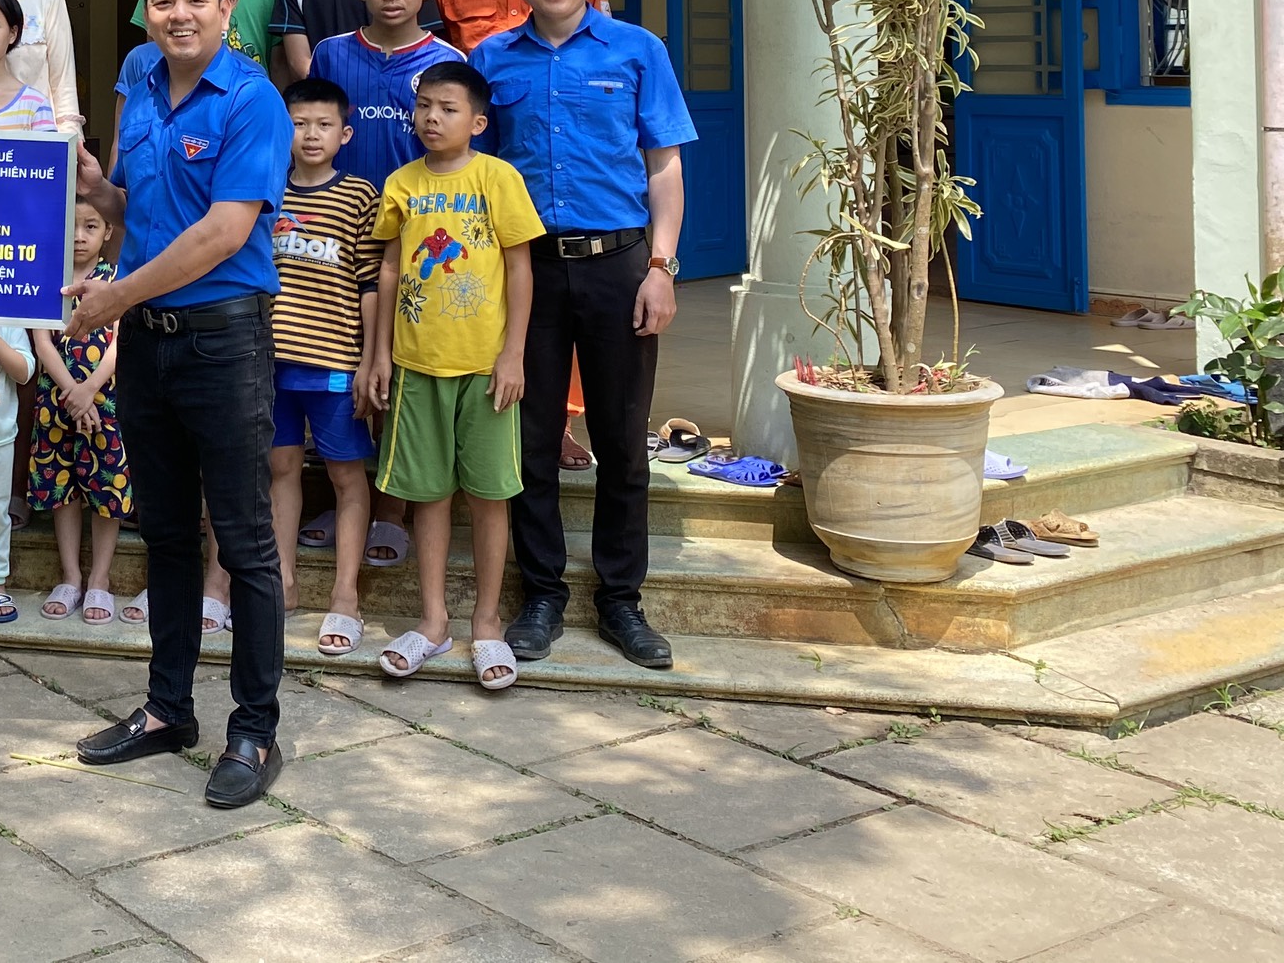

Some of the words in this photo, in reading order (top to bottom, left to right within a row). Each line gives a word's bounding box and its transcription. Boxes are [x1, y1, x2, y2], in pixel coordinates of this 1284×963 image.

[30, 166, 55, 179] HUẾ
[18, 244, 36, 262] TƠ
[15, 283, 40, 296] TÂY
